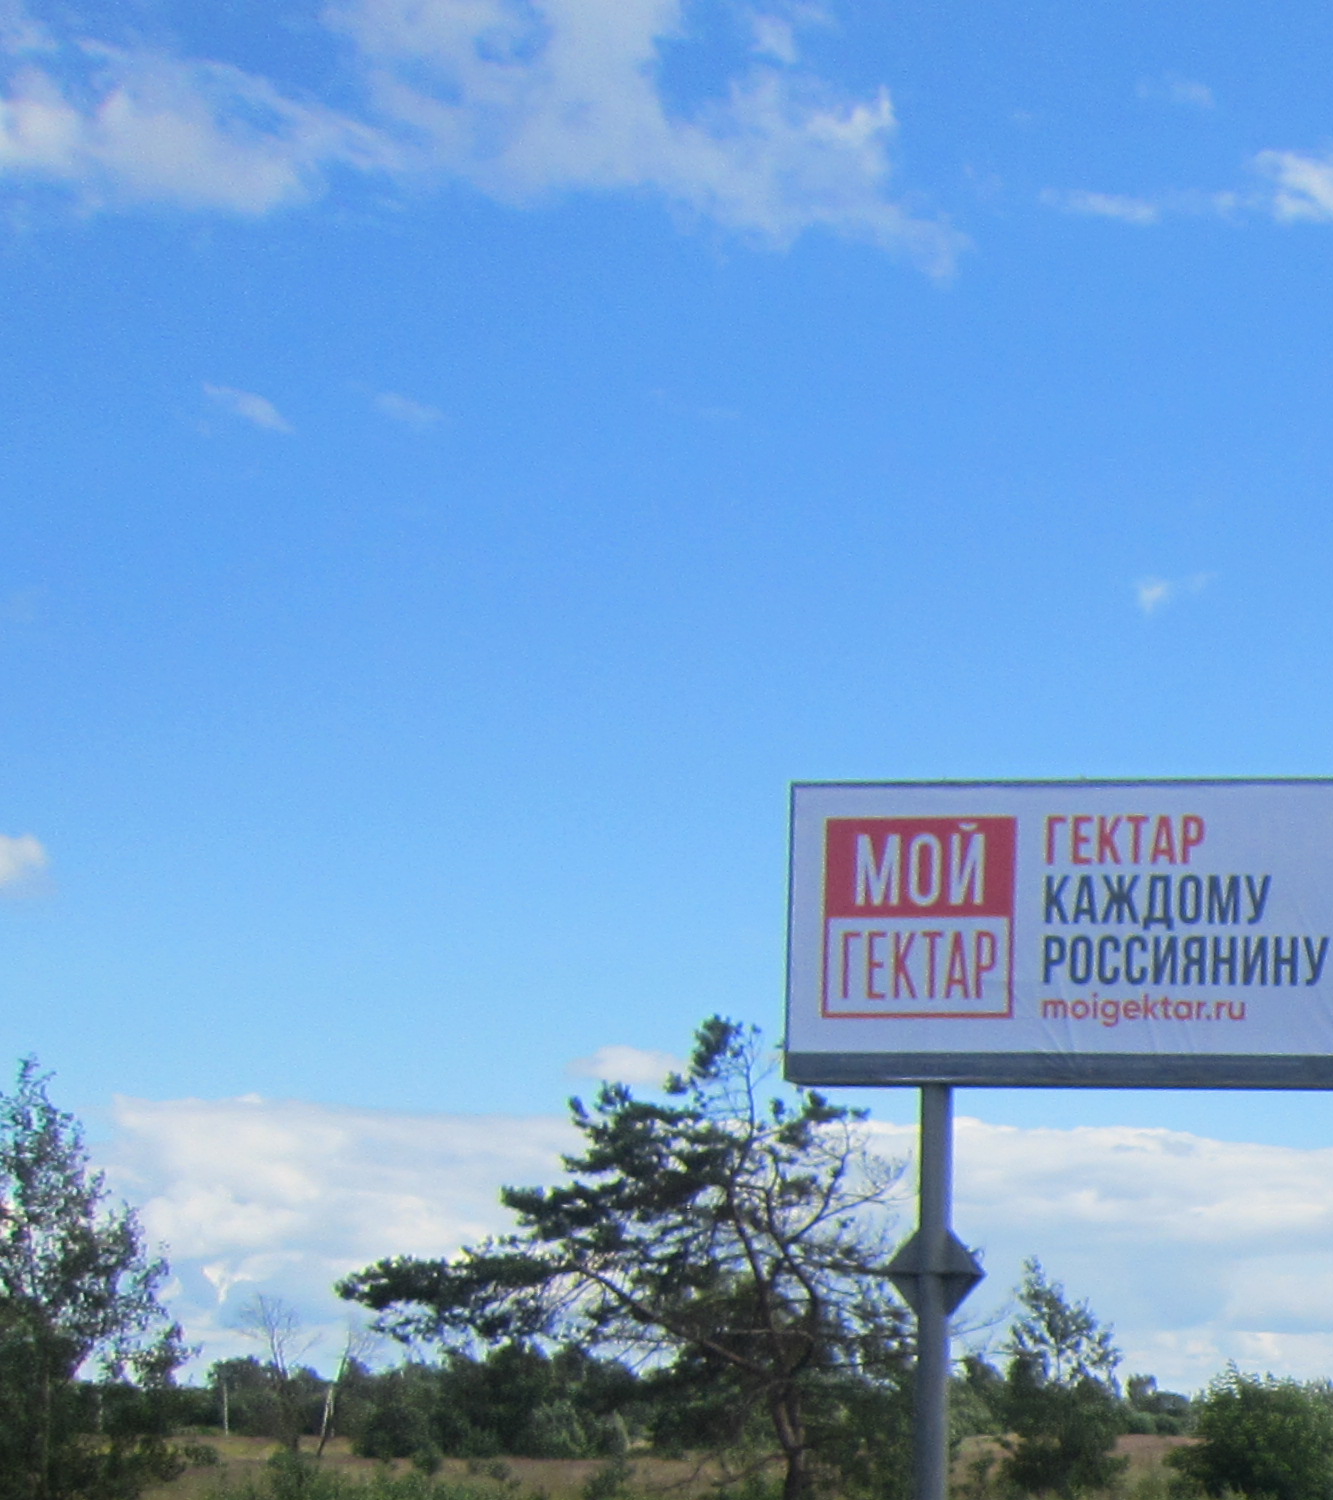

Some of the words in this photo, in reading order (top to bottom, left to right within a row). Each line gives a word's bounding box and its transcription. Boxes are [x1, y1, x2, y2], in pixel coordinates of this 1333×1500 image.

[854, 824, 987, 907] МОЙ
[1045, 815, 1205, 865] ГЕКТАР
[1043, 874, 1272, 931] КАЖДОМУ
[841, 931, 997, 999] ГЕКТАР
[1043, 935, 1330, 987] РОССИЯНИНУ
[1042, 993, 1246, 1027] moigektar.ru
